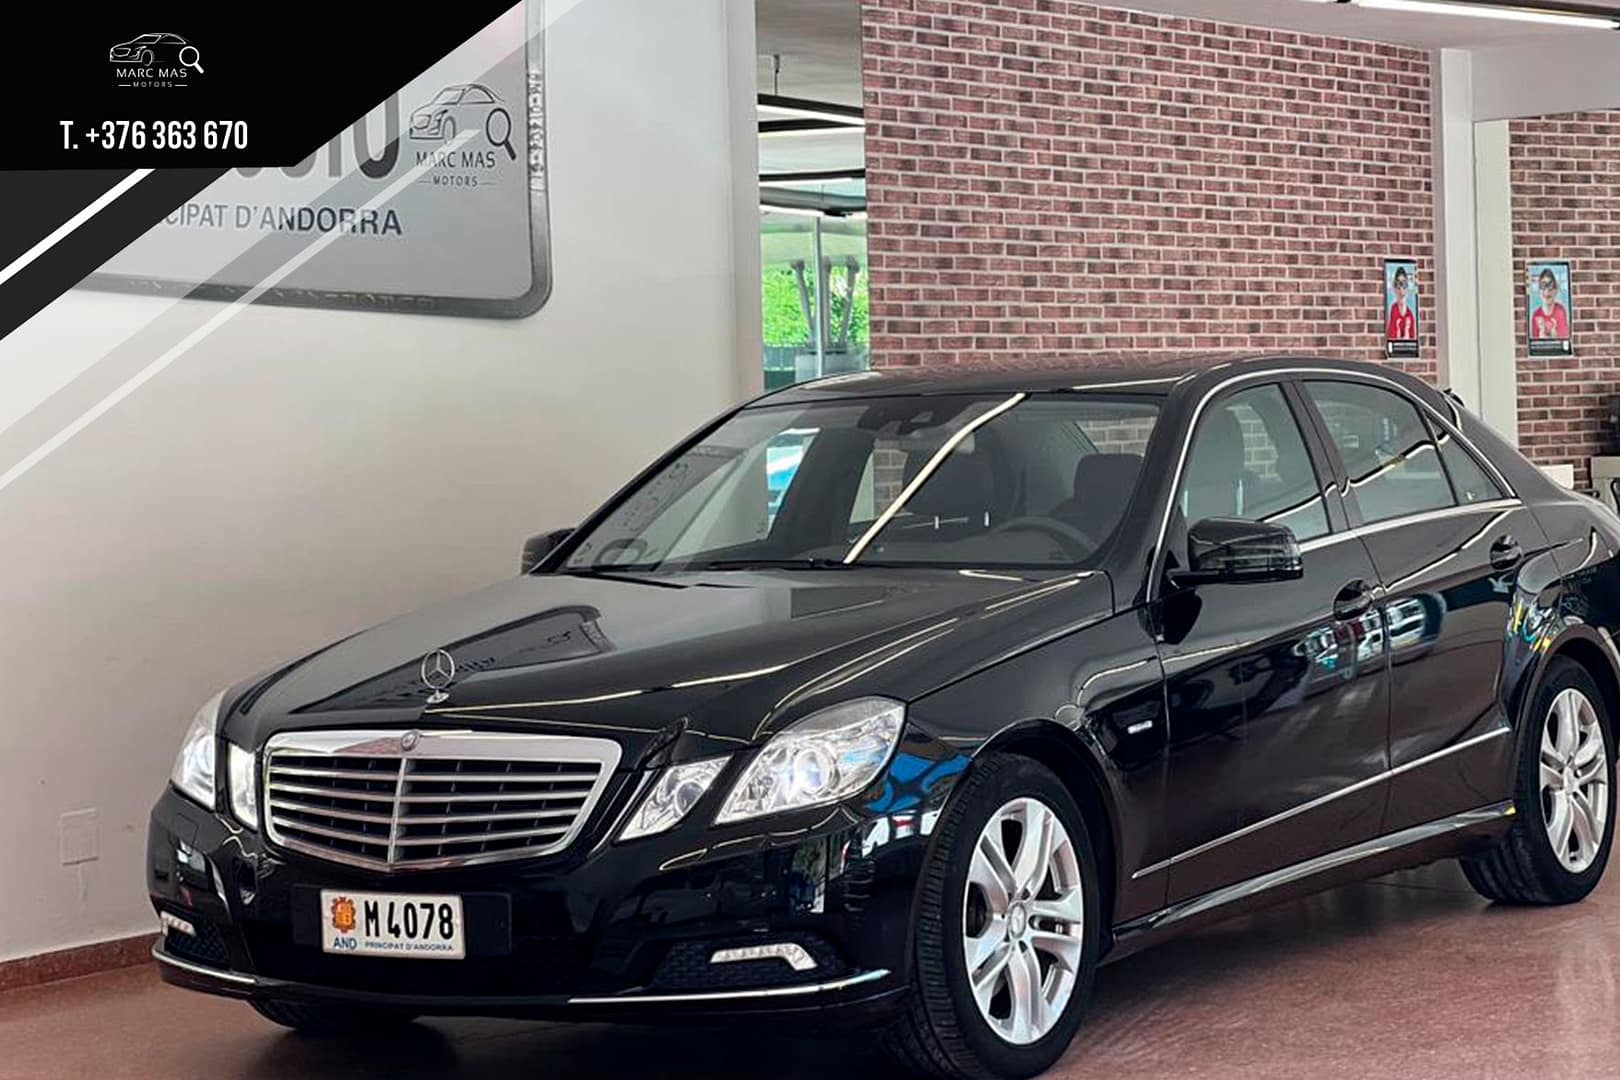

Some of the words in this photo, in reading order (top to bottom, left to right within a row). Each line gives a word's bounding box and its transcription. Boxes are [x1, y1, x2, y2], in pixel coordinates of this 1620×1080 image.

[415, 151, 457, 168] MARC
[461, 151, 496, 168] MAS
[433, 175, 479, 187] MOTORS
[364, 900, 380, 937] M
[387, 901, 454, 940] 4078
[333, 937, 357, 951] AND
[365, 941, 404, 951] PRINCIPAT
[406, 943, 453, 952] D'ANDORRA
